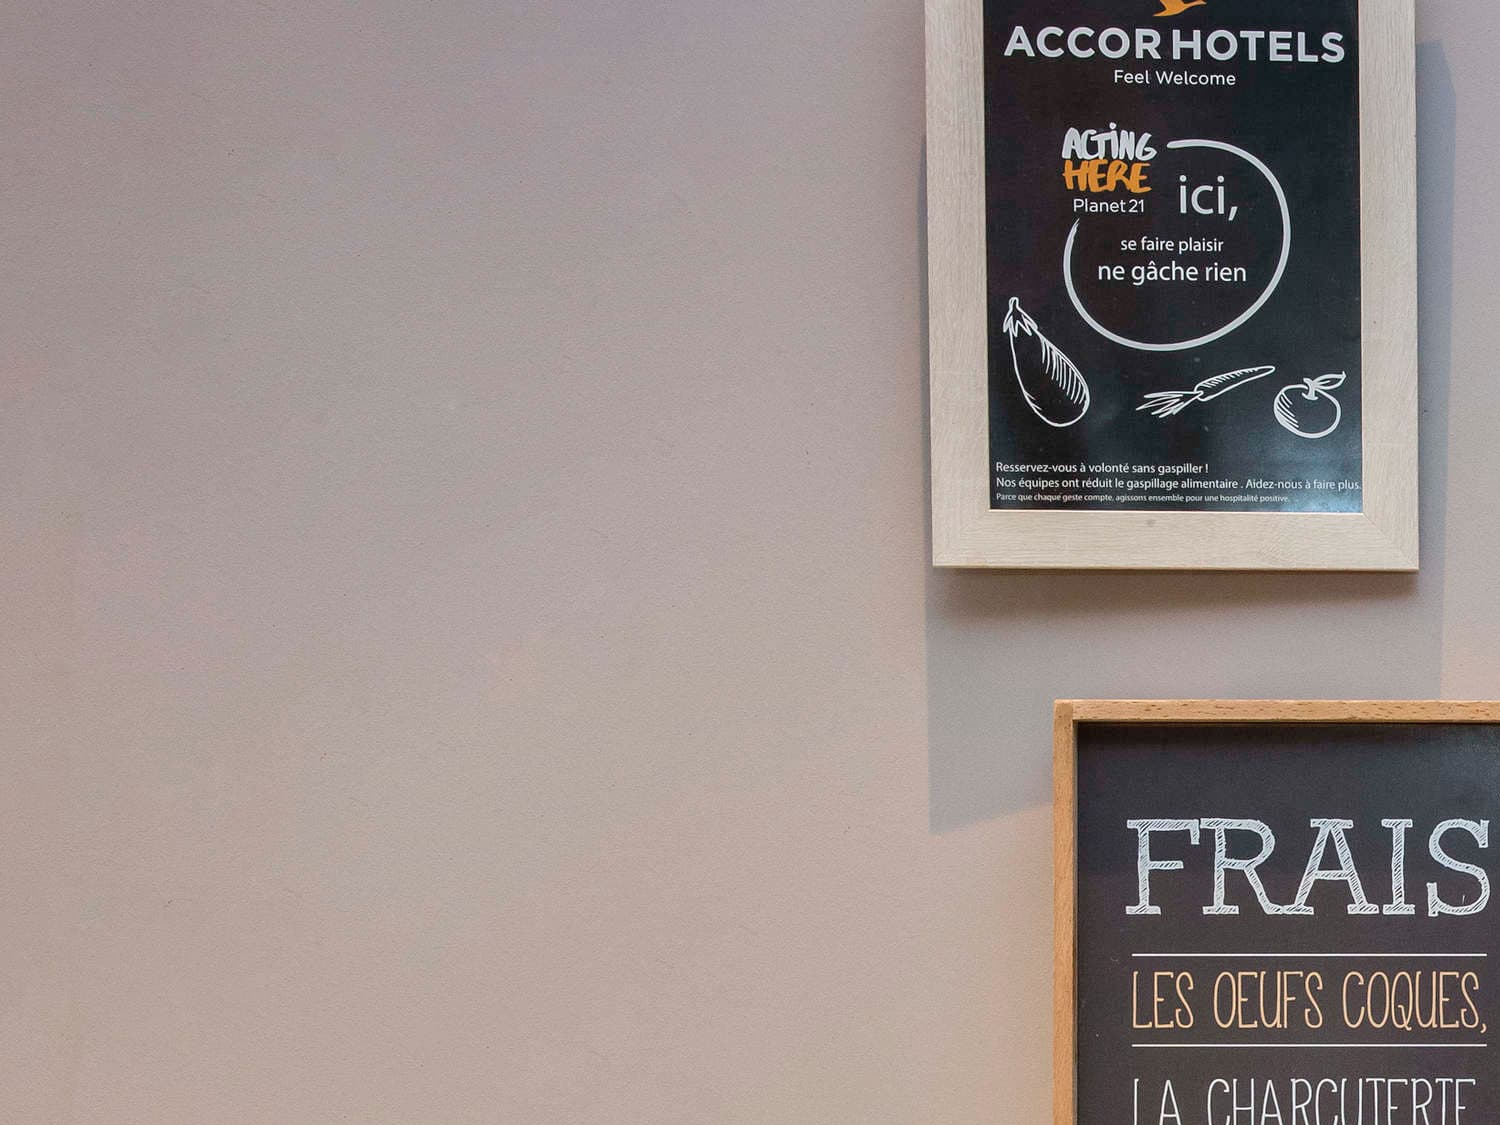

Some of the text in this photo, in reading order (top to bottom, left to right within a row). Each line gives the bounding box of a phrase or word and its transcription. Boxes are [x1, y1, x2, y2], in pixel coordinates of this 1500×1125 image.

[1114, 69, 1237, 86] Feel Welcome
[1062, 159, 1153, 194] HERE
[1073, 198, 1145, 213] Planet 21
[1178, 174, 1239, 222] ici,
[1120, 236, 1225, 254] se faire plaisir
[1098, 260, 1247, 286] ne gâche rien
[996, 462, 1078, 473] Resservez-vous
[1079, 462, 1086, 473] à
[1088, 462, 1130, 473] volonté
[1132, 464, 1156, 473] sans
[1157, 463, 1204, 475] gaspiller
[996, 478, 1016, 488] Nos
[1018, 477, 1060, 490] équipes
[1061, 479, 1080, 488] ont
[1081, 477, 1113, 489] réduit
[1115, 478, 1125, 488] le
[1126, 478, 1178, 491] gaspillage
[1181, 479, 1239, 489] alimentaire
[1246, 479, 1303, 490] Aidez-nous
[1305, 480, 1311, 490] à
[1313, 479, 1336, 490] faire
[996, 493, 1017, 501] Parce
[1017, 495, 1033, 503] que
[1033, 493, 1061, 503] chaque
[1062, 495, 1083, 503] geste
[1115, 495, 1148, 503] agissons
[1148, 494, 1185, 502] ensemble
[1185, 495, 1203, 503] pour
[1219, 494, 1259, 503] hospitalité
[1125, 818, 1491, 917] FRAIS
[1132, 971, 1488, 1034] LES OEUFS COQUES,
